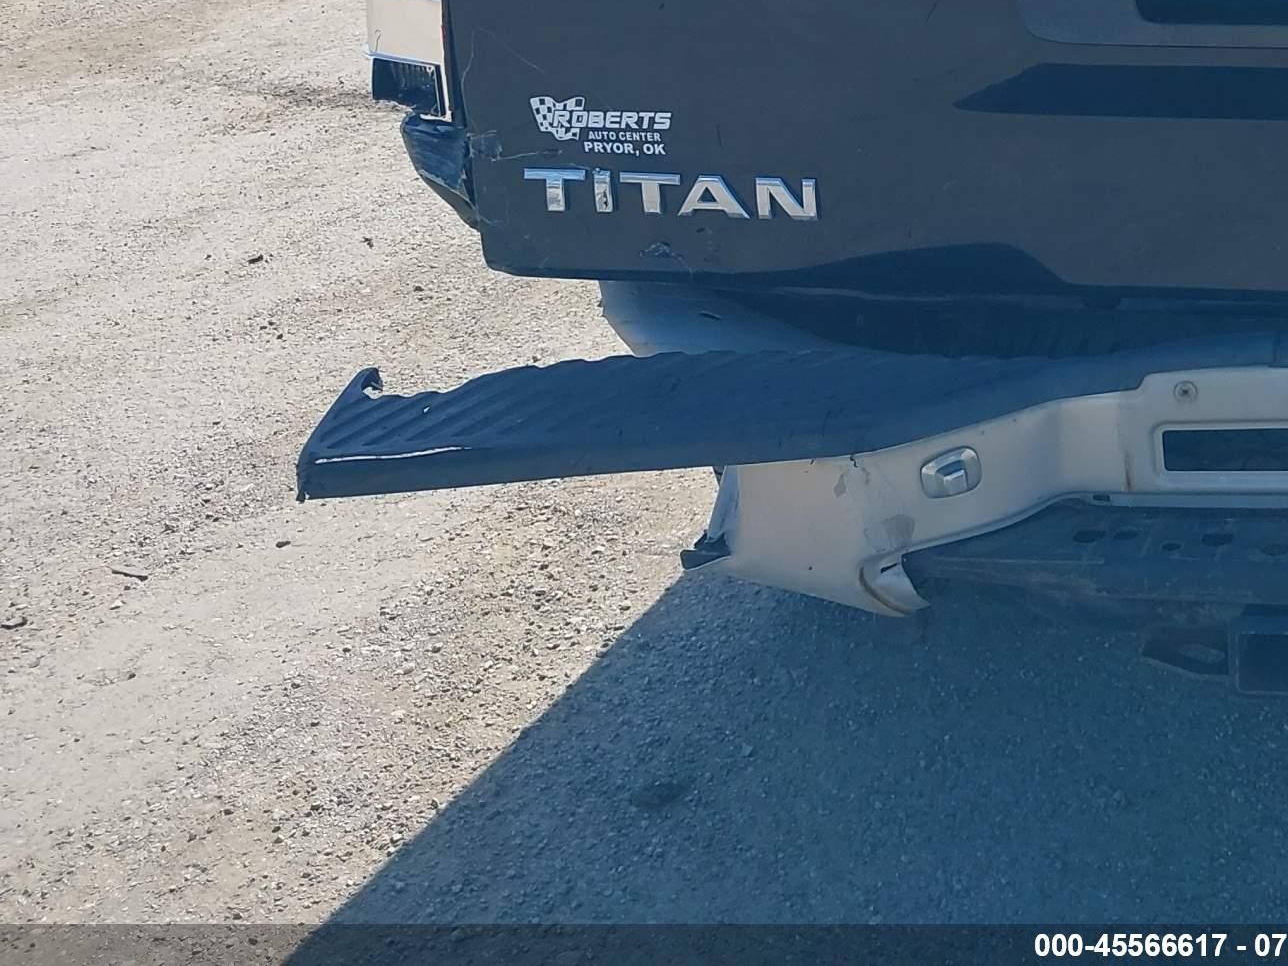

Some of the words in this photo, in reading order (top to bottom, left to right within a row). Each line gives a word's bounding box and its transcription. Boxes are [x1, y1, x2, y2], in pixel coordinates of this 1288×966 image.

[552, 110, 672, 130] ROBERTS
[588, 131, 616, 141] AUTO
[618, 131, 661, 142] CENTER
[583, 141, 640, 156] PRYOR,
[642, 143, 666, 155] OK
[523, 167, 818, 221] TITAN
